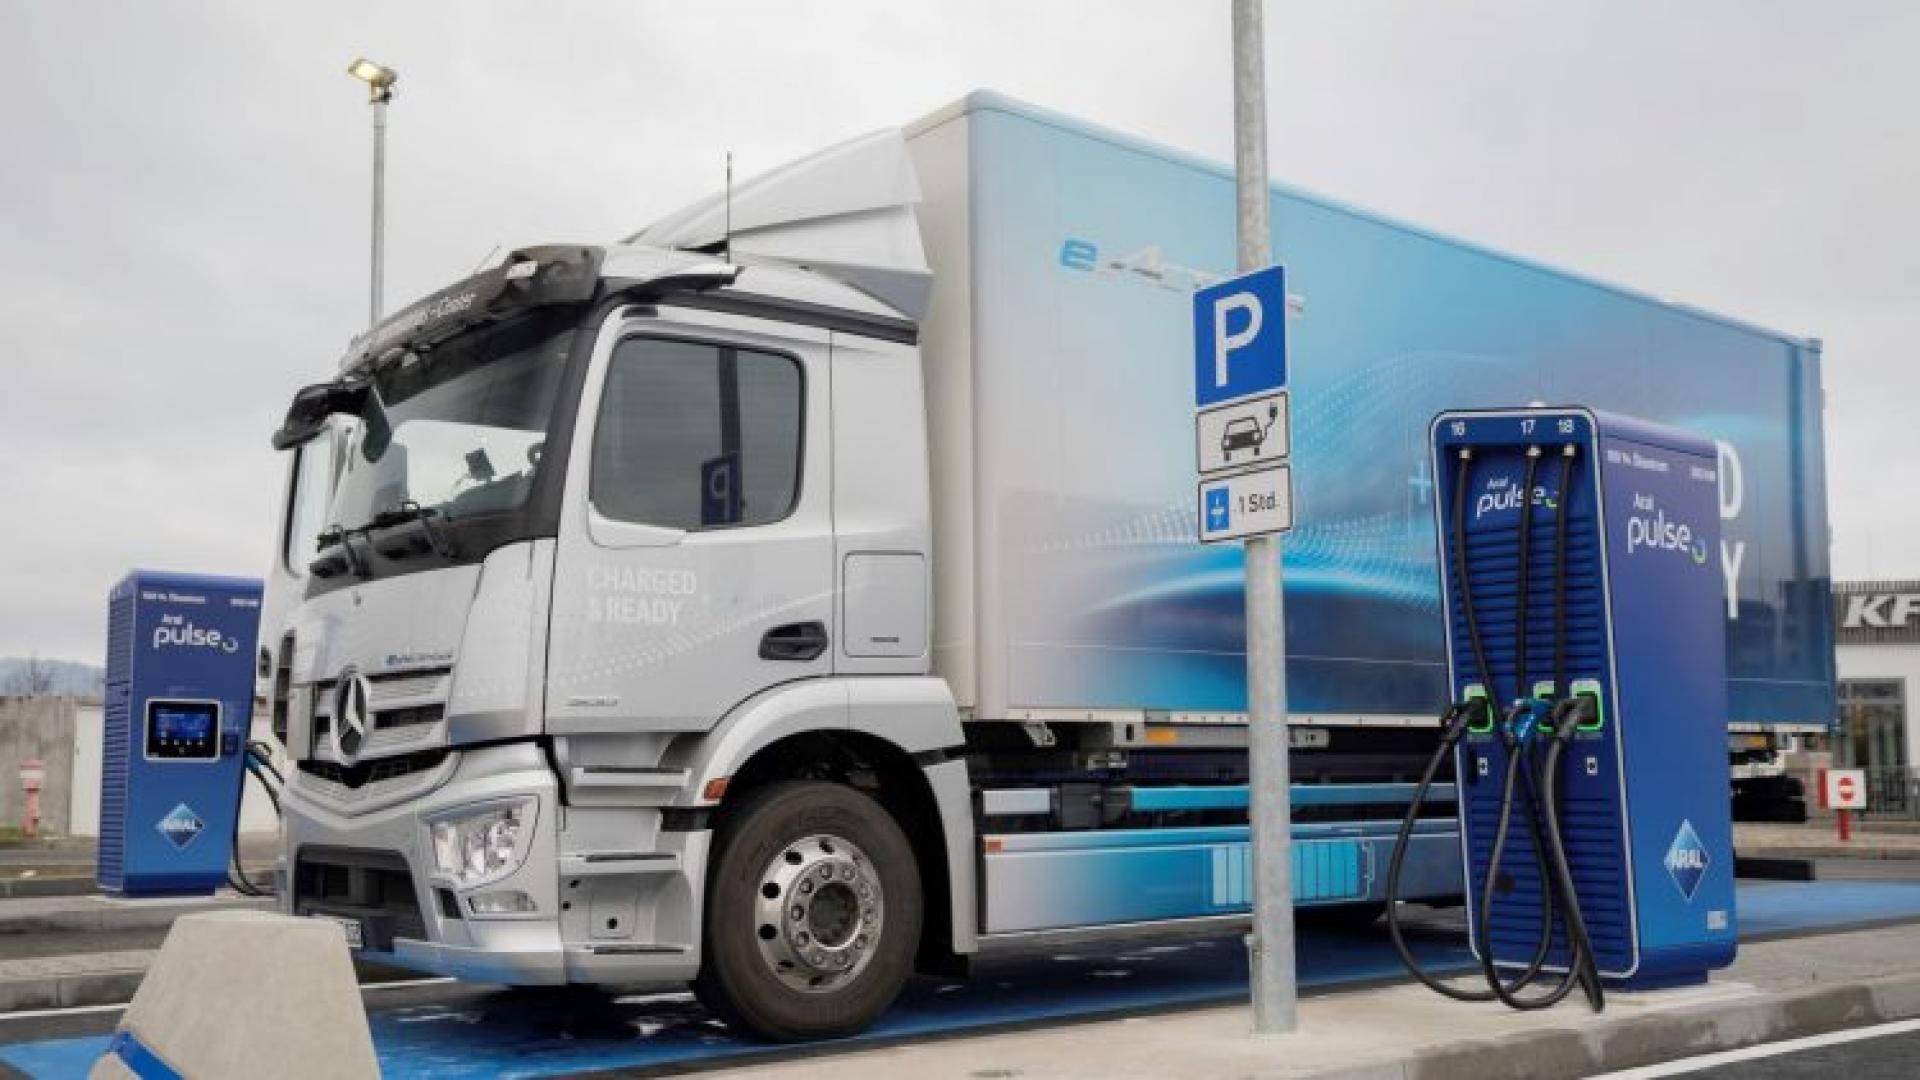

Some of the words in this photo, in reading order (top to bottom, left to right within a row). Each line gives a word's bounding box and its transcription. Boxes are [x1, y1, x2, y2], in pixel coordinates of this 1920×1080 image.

[1215, 291, 1262, 387] P
[1451, 421, 1466, 436] 16
[1520, 419, 1536, 435] 17
[1558, 419, 1574, 434] 18
[1238, 495, 1245, 513] 1
[1627, 508, 1691, 554] pulse
[587, 566, 697, 595] CHARGED
[606, 596, 685, 626] READY
[153, 621, 222, 649] pulse
